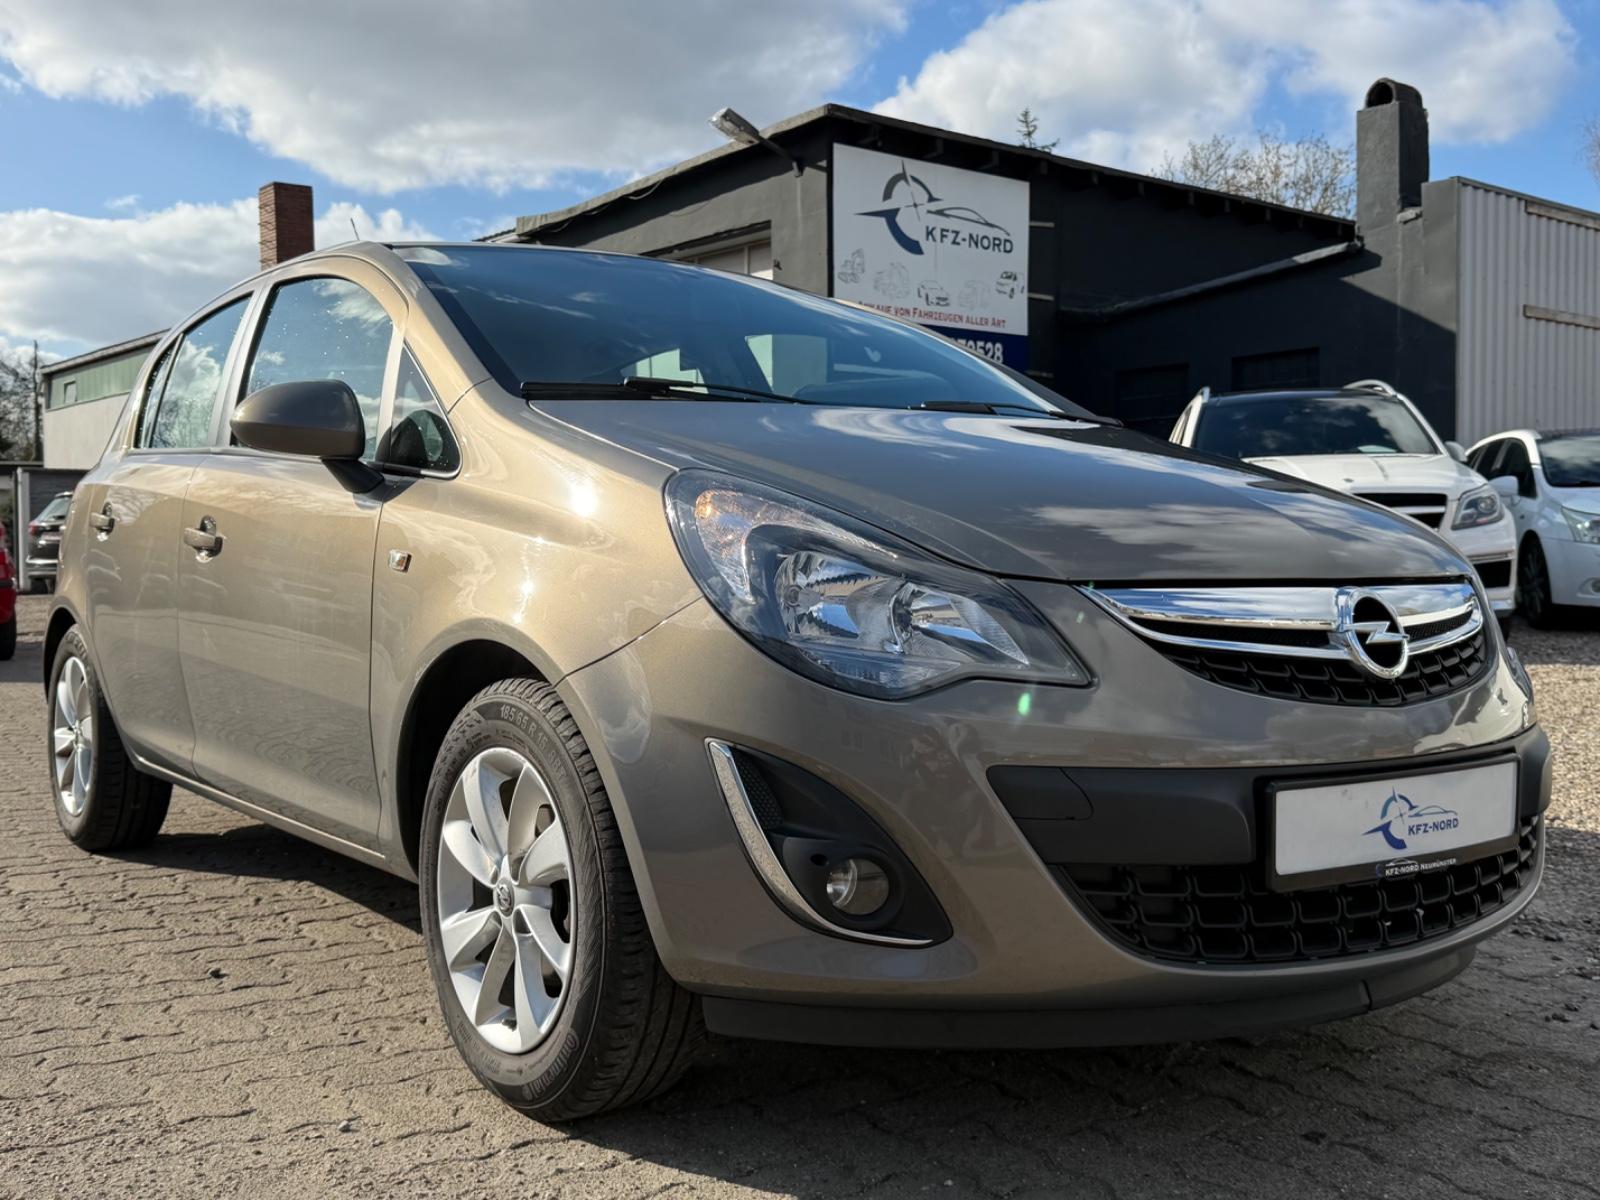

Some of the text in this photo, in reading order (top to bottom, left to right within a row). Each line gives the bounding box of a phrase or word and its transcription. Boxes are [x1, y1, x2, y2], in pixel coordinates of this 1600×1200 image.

[925, 226, 1014, 254] KFZ-NORD
[1408, 818, 1459, 836] KFZ-NORD
[1385, 864, 1419, 876] KFZ-NORD
